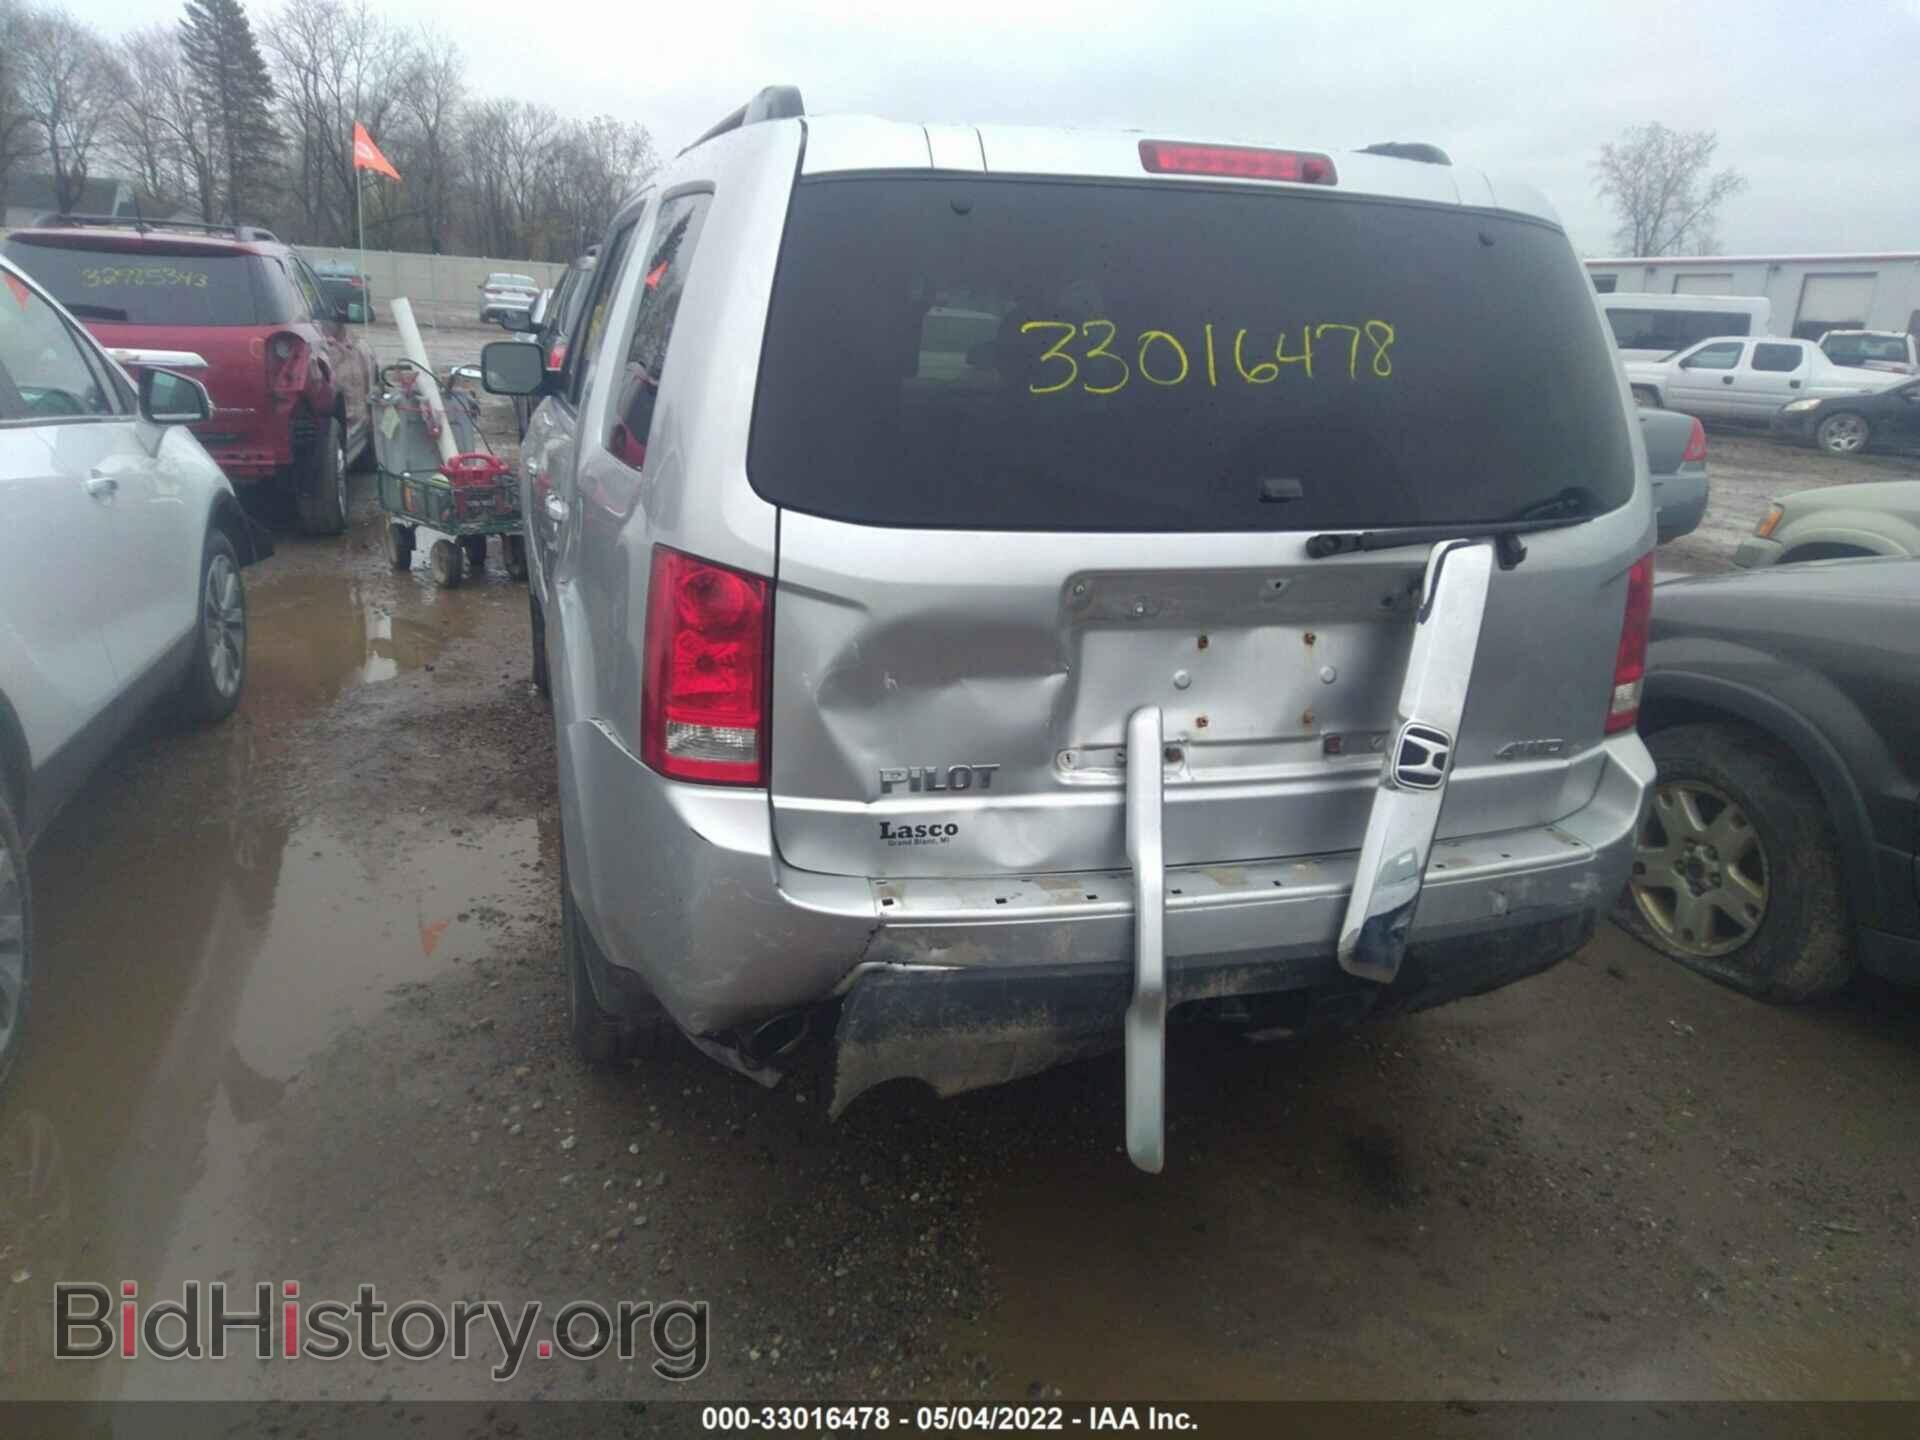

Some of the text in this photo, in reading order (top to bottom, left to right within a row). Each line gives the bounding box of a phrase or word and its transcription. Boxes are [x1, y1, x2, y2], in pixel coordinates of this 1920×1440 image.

[1021, 320, 1395, 394] 33016478
[879, 763, 1001, 794] PILOT
[879, 821, 959, 840] Lasco
